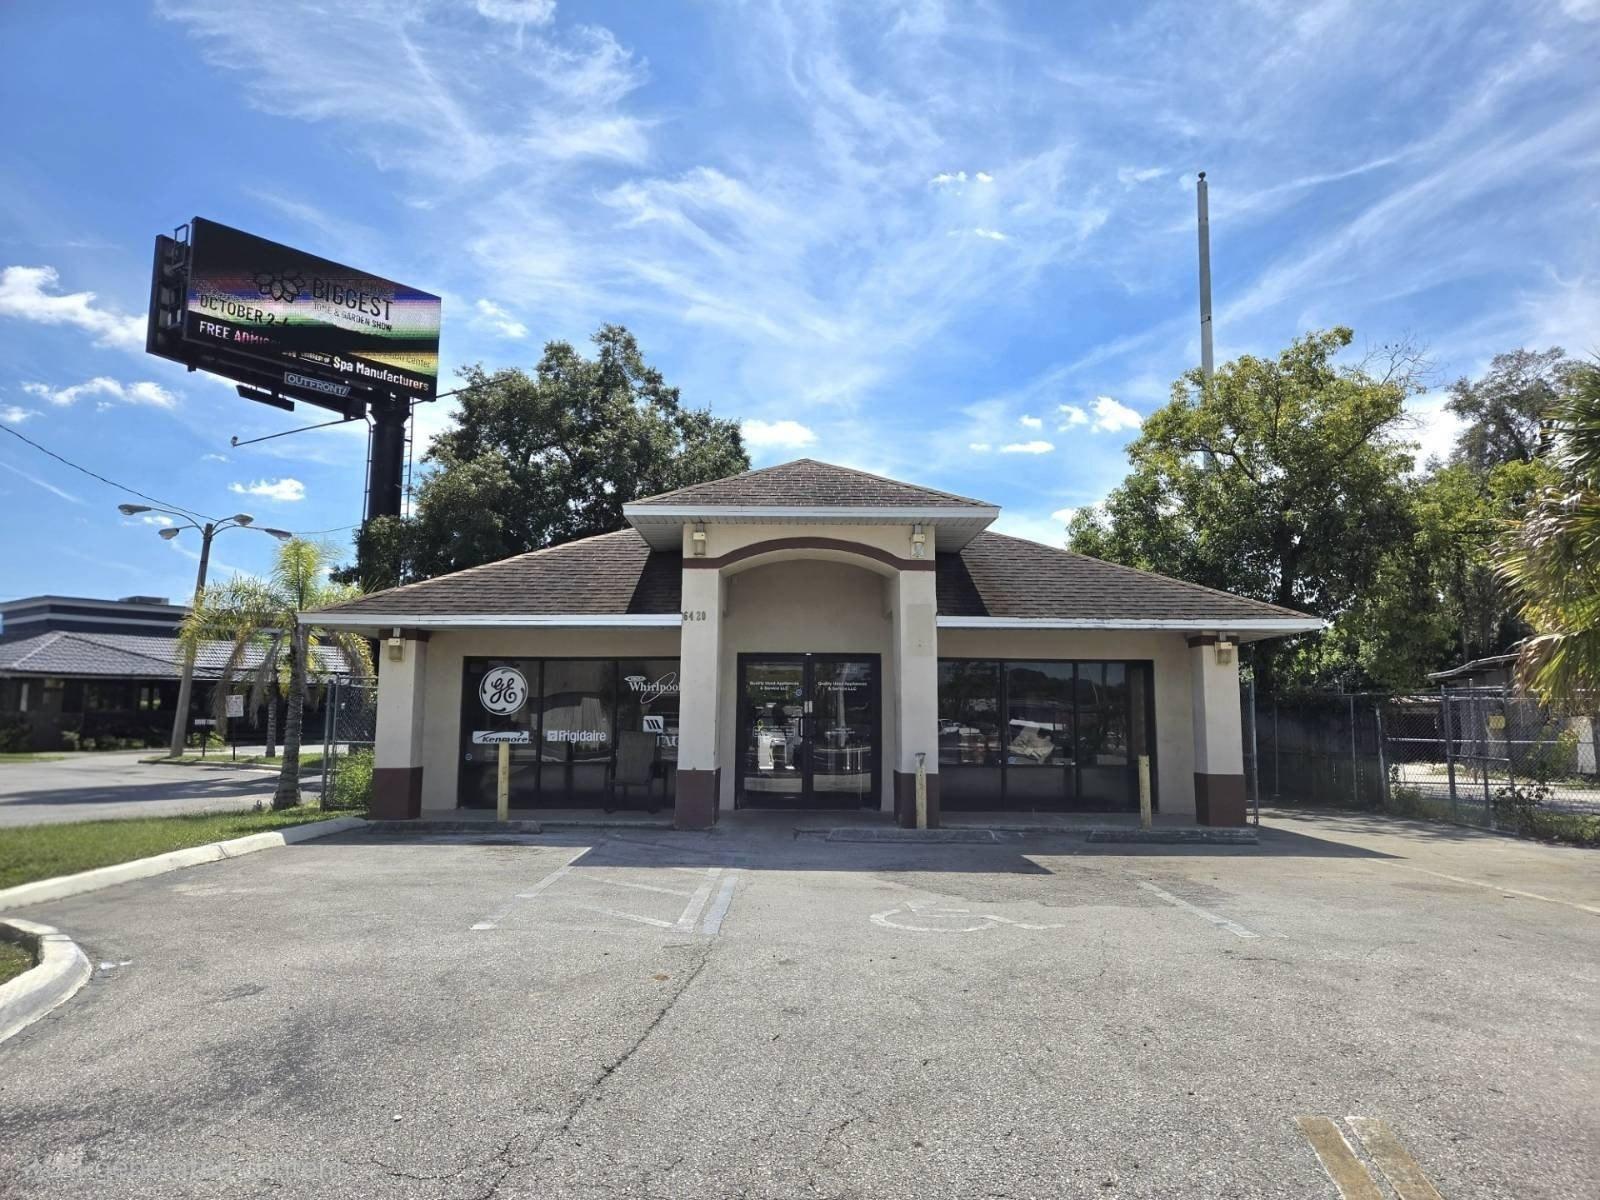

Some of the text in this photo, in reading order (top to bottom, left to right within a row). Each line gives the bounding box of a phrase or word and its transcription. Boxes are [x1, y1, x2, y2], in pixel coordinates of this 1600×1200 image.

[200, 295, 263, 323] OCTOBER
[313, 278, 393, 320] BIGGEST
[199, 320, 231, 340] FREE
[371, 314, 392, 331] SHOW
[333, 356, 353, 372] Spa
[356, 361, 429, 392] Manufacturers
[684, 610, 706, 621] 6420
[558, 729, 606, 743] Frigidaire
